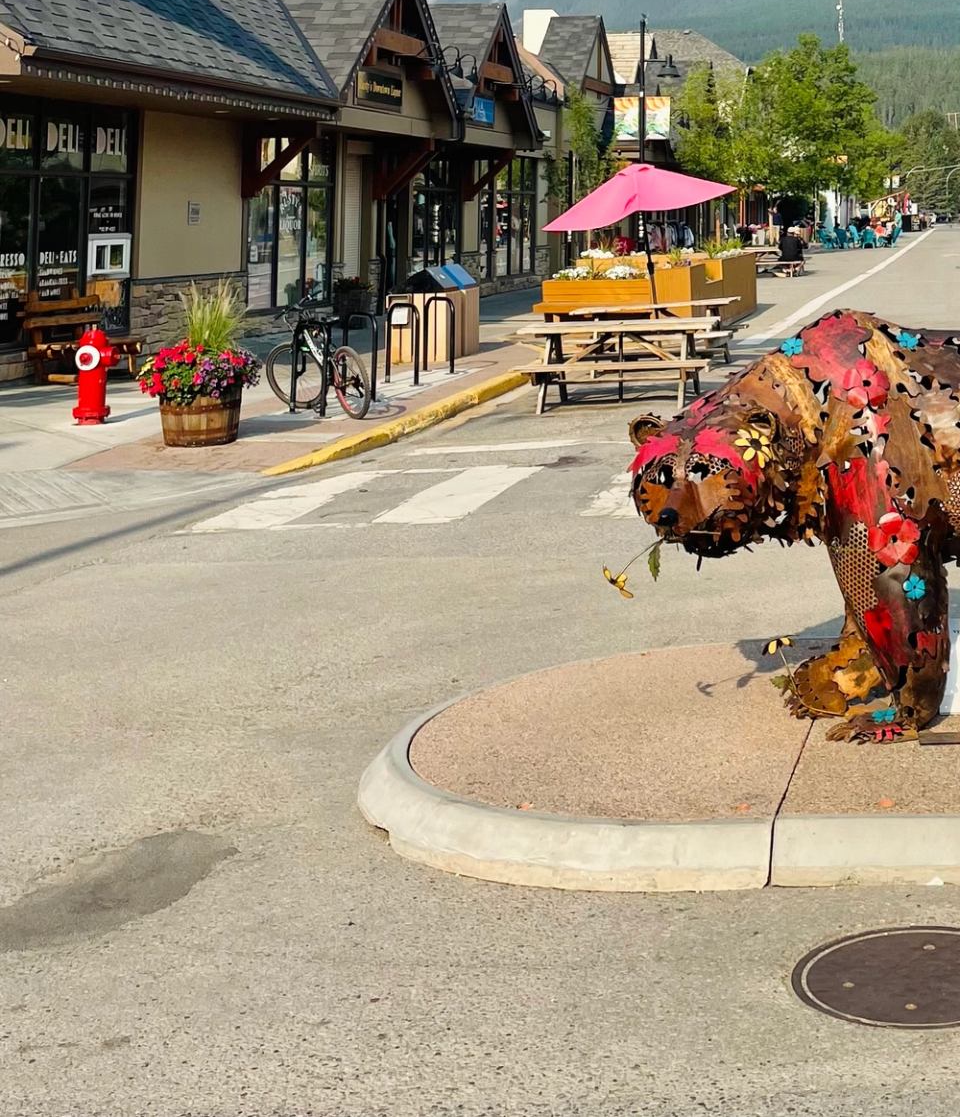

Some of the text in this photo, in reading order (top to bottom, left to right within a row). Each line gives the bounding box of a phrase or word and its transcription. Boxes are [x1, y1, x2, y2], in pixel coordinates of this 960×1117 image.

[47, 122, 79, 153] DELI
[97, 127, 125, 156] DELI
[40, 250, 77, 265] DELI EATS
